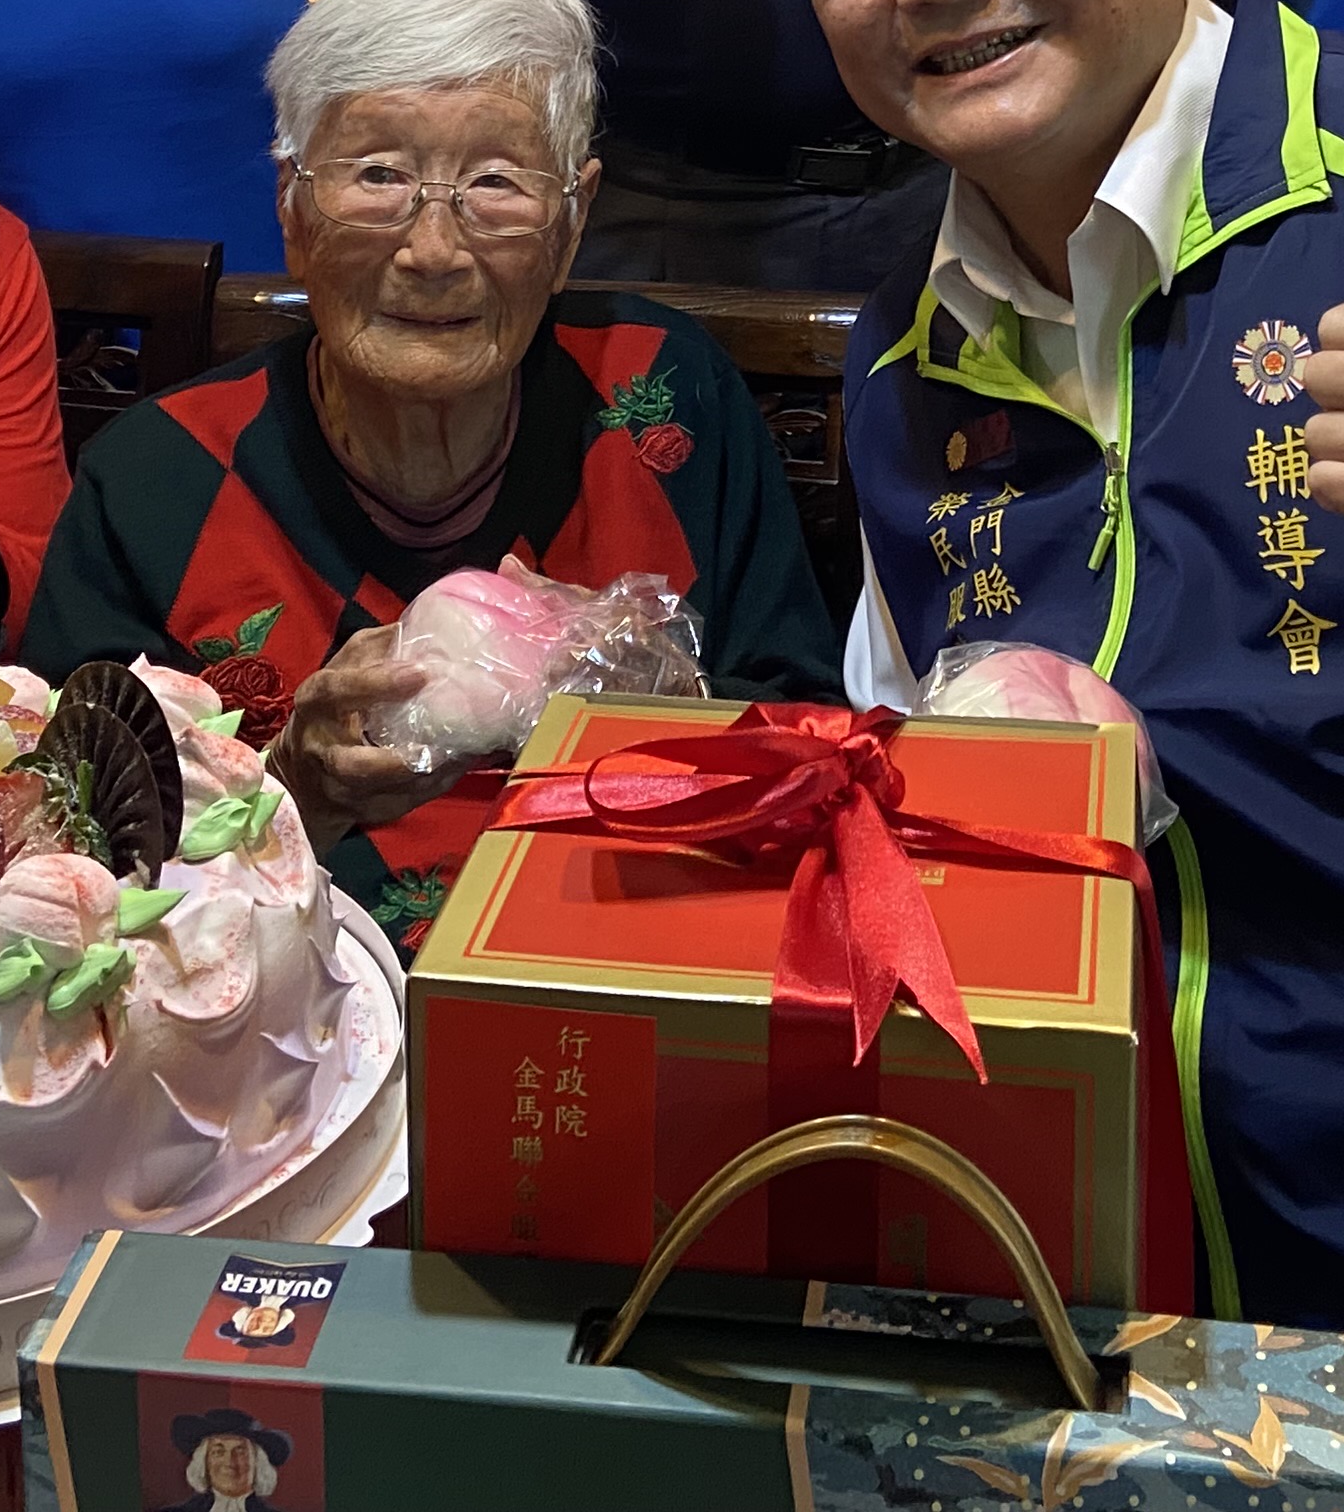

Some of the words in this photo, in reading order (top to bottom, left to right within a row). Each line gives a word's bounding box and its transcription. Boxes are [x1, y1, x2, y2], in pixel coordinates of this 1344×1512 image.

[925, 491, 972, 646] 榮民服
[1244, 424, 1338, 676] 輔導會
[555, 1025, 591, 1138] 行政院
[220, 1272, 333, 1299] QUAKER
